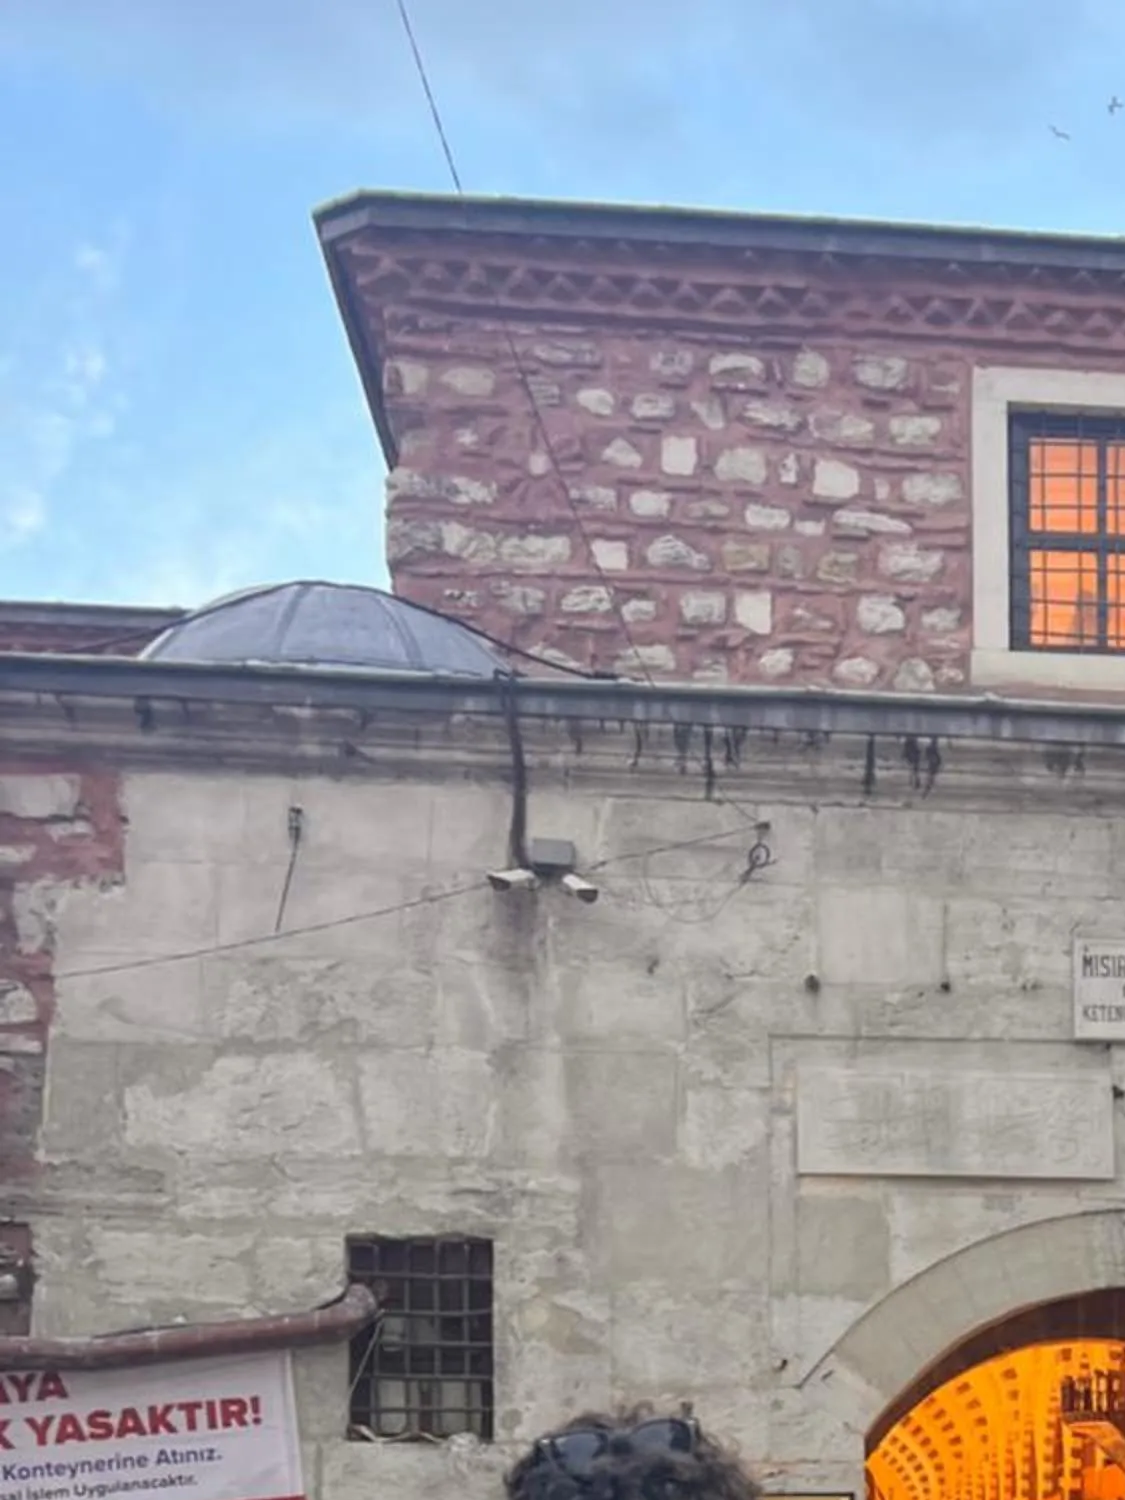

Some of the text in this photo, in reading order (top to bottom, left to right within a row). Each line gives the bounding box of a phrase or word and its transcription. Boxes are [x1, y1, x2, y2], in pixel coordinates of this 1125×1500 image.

[24, 1396, 264, 1448] YASAKTIR!
[2, 1446, 223, 1482] Konteynerine Atınız.
